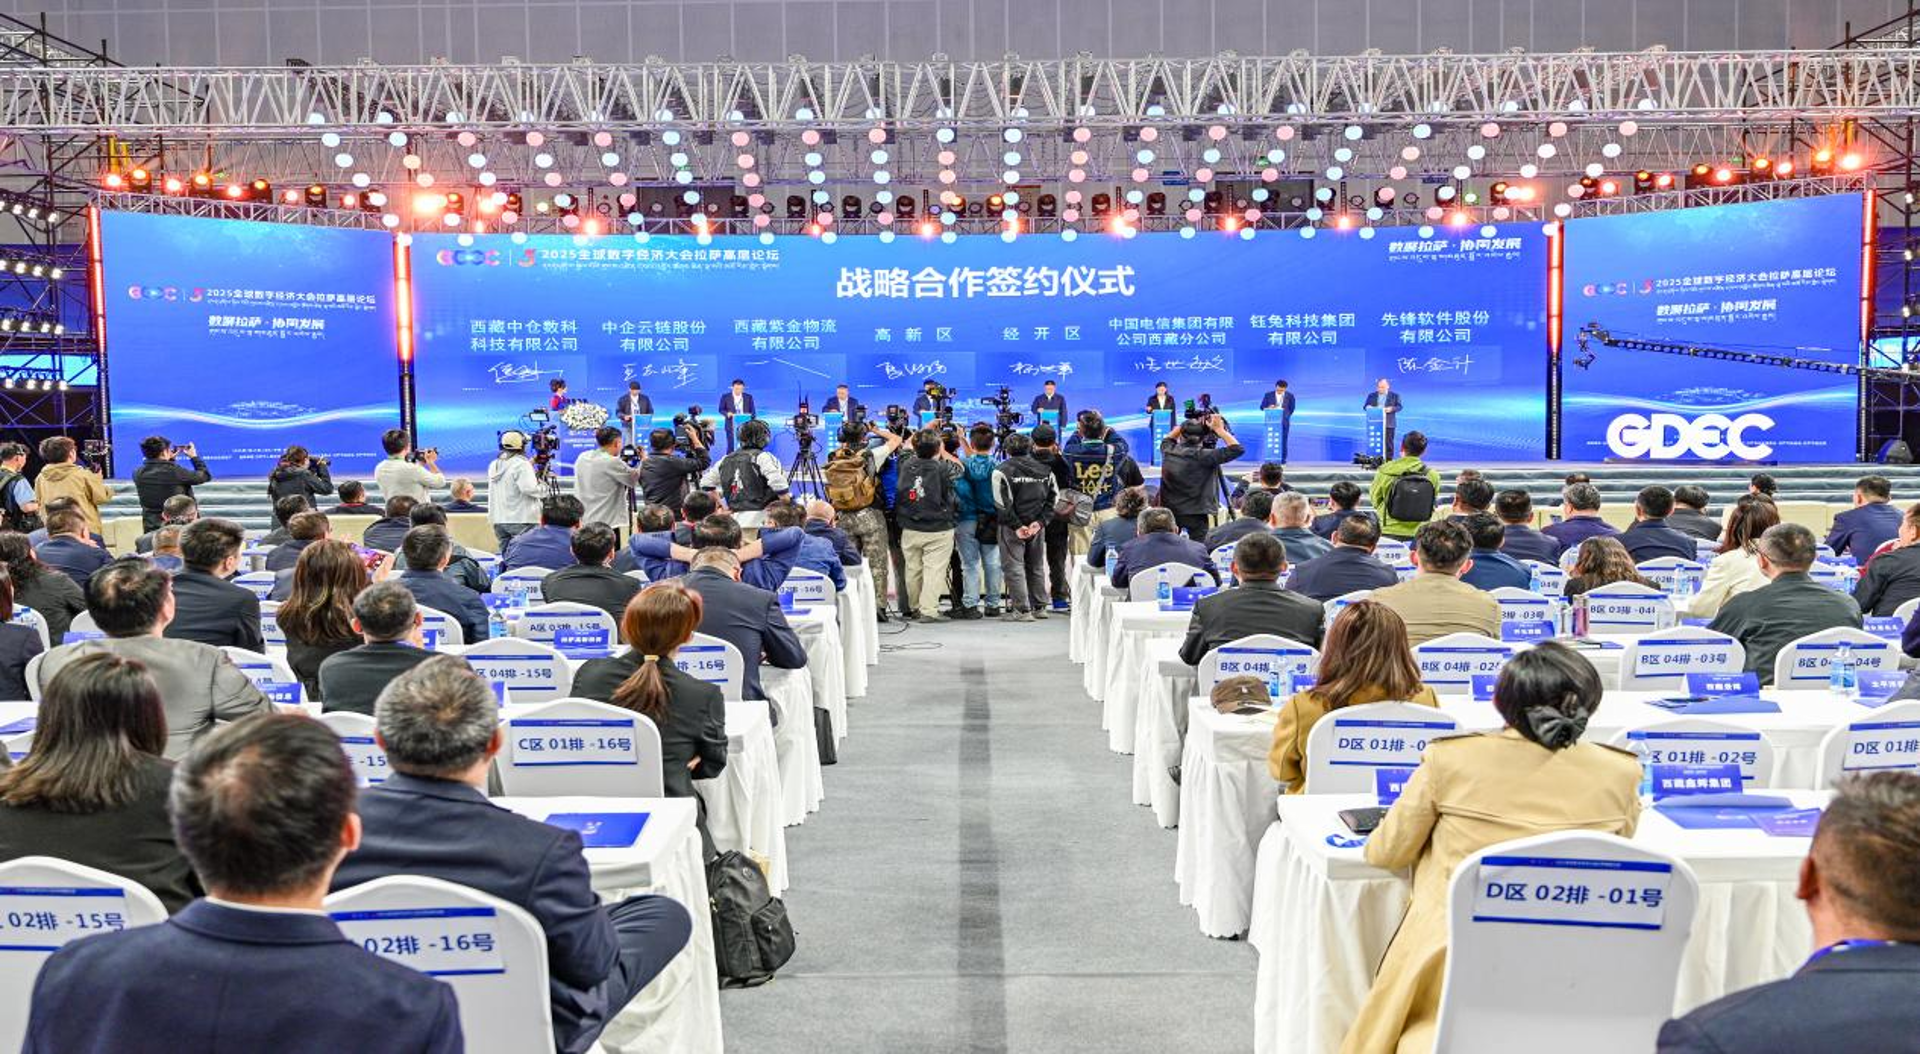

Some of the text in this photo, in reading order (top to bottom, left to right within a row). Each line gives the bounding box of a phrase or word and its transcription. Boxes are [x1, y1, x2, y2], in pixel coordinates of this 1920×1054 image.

[836, 265, 1135, 299] 战略合作签约仪式
[734, 319, 837, 334] 西藏紫金物流
[1108, 316, 1234, 331] 中国电信集团有限
[1249, 314, 1356, 329] 钰兔科技集团
[1381, 311, 1490, 327] 先锋软件股份
[470, 320, 578, 334] 西藏中仓数科
[602, 320, 707, 335] 中企云链股份
[874, 327, 954, 342] 高新区
[1003, 326, 1081, 342] 经开区
[751, 336, 821, 350] 有限公司
[1116, 332, 1227, 346] 公司西藏分公司
[1267, 330, 1338, 346] 有限公司
[1400, 329, 1472, 344] 有限公司
[470, 338, 578, 352] 科技有限公司
[619, 338, 690, 352] 有限公司
[1606, 413, 1777, 460] GDEC
[1075, 461, 1114, 478] Lee
[692, 659, 726, 671] -16号
[1641, 653, 1727, 665] B区 04排 -03号
[1798, 657, 1818, 668] B区
[490, 668, 517, 678] 04排
[520, 668, 553, 678] -15号
[1220, 661, 1240, 673] B区
[1421, 661, 1501, 673] B区 04排 -02
[518, 737, 632, 752] C区 01排 -16号
[1338, 738, 1366, 750] D区
[1370, 737, 1406, 752] 01排
[1854, 740, 1881, 755] D区
[359, 755, 387, 767] -15
[1667, 750, 1706, 764] 01排
[1710, 750, 1757, 765] -02号
[1486, 882, 1664, 908] D区 02排 -01号
[8, 910, 126, 932] 02排 -15号
[363, 932, 496, 955] 02排 -16号
